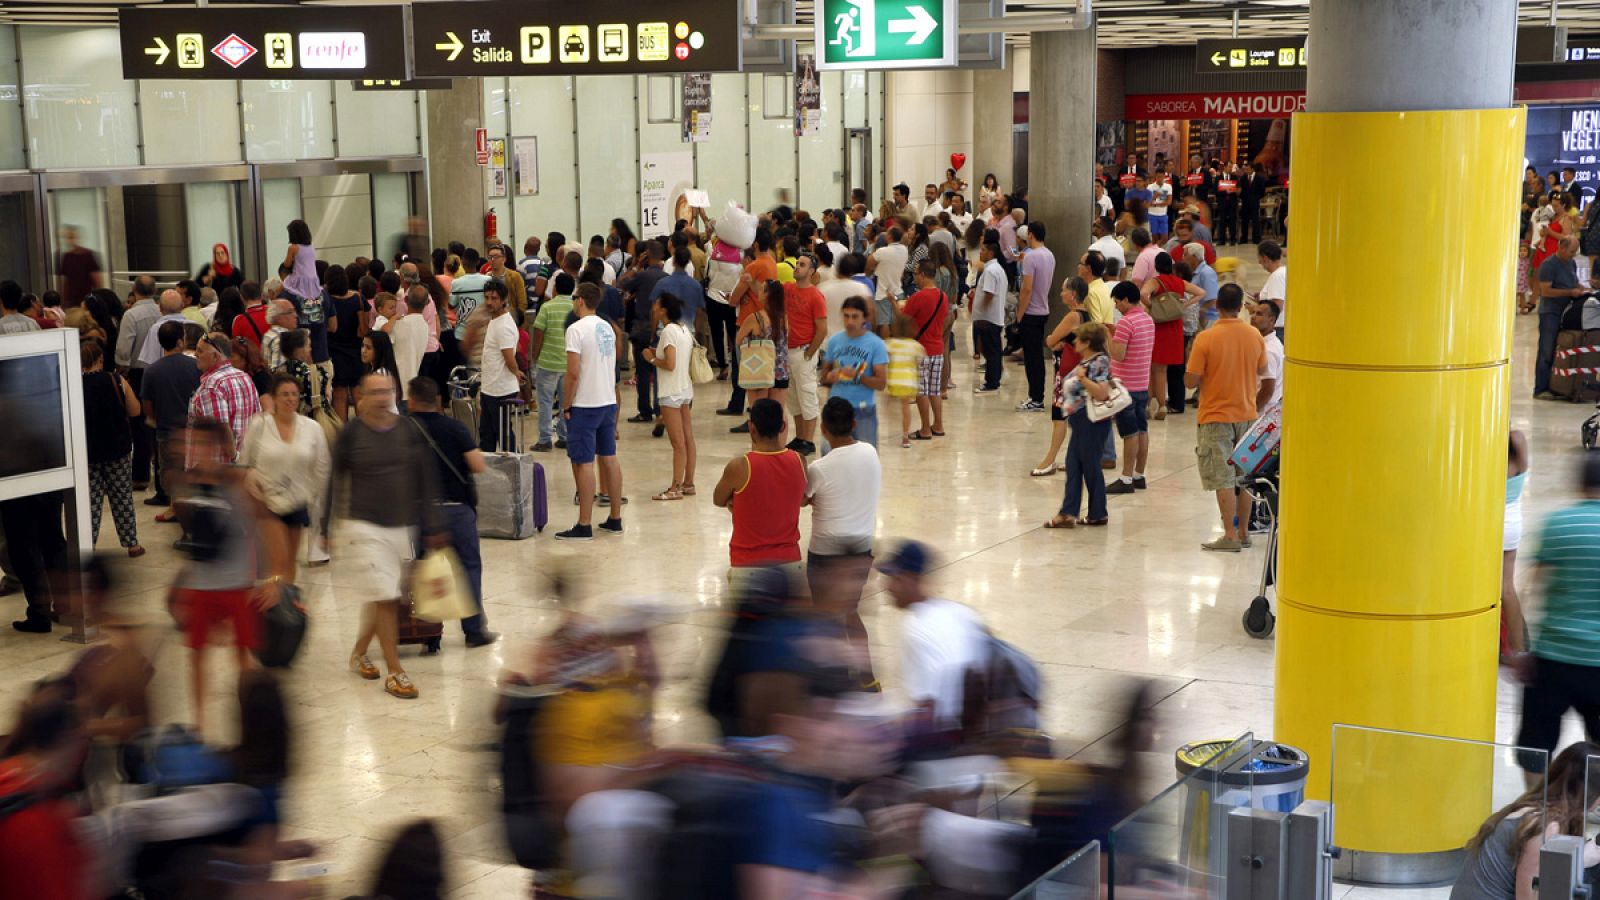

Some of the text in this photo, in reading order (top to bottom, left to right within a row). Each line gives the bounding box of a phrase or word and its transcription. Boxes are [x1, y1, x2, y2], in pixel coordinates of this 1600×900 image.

[471, 28, 491, 43] Exit
[639, 35, 656, 49] BUS
[306, 40, 359, 62] renfe
[529, 33, 544, 57] P
[472, 47, 513, 62] Salida
[1281, 51, 1294, 62] 10
[1147, 100, 1197, 113] SABOREA
[644, 180, 665, 192] Aparca
[643, 206, 659, 227] 1€
